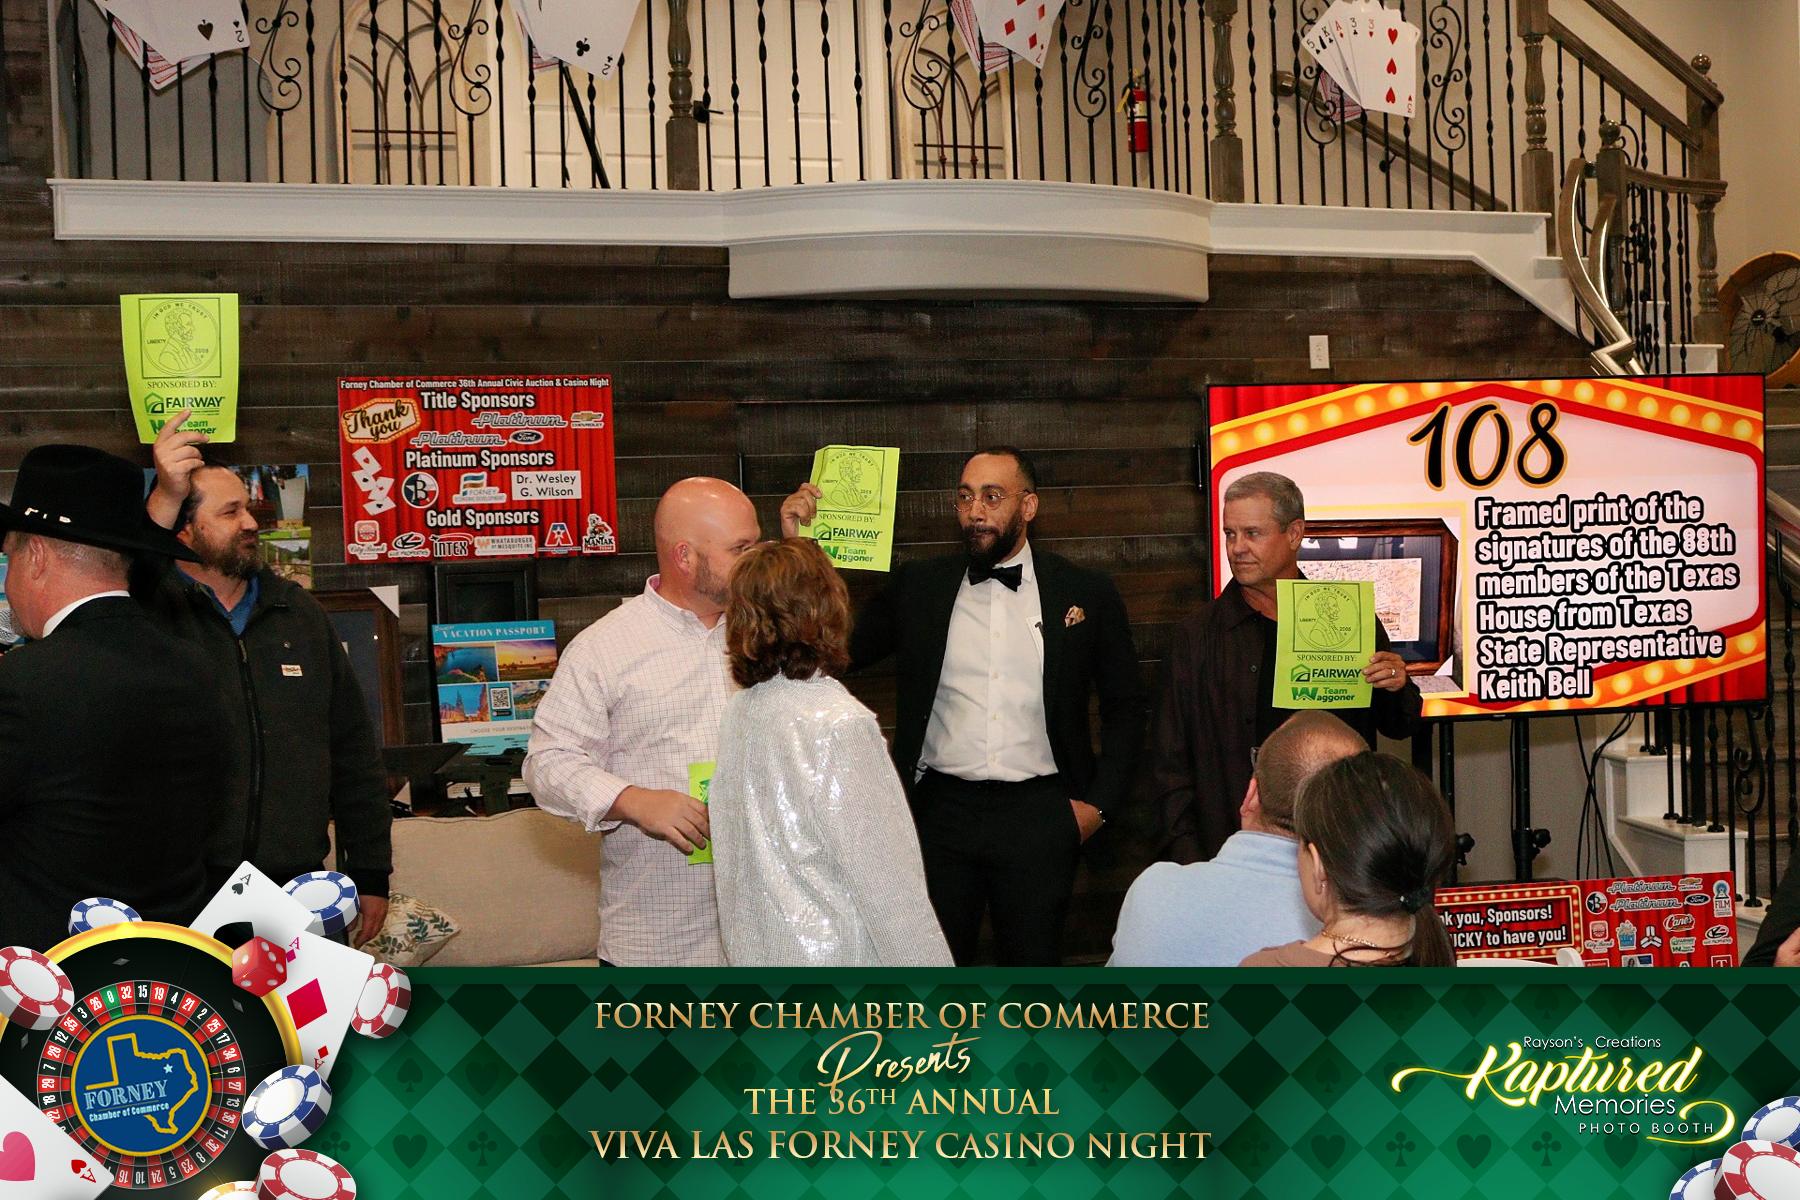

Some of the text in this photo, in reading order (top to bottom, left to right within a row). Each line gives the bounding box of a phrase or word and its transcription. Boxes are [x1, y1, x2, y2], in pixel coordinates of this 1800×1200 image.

[1335, 20, 1342, 31] A
[1350, 17, 1358, 28] 3
[1368, 19, 1375, 30] 3
[1321, 26, 1331, 38] K
[1306, 38, 1316, 49] 5
[147, 380, 217, 389] SPONSORED BY:
[340, 378, 609, 390] Forney Chamber of Commerce 36th Annual Civic Auction & Casino Night
[166, 396, 223, 408] FAIRWAY
[420, 391, 535, 412] Title Sponsors
[343, 399, 410, 434] Thank
[472, 412, 567, 428] Platinum
[184, 420, 209, 428] eam
[370, 421, 401, 442] you
[411, 431, 537, 446] Platinum Ford
[1407, 400, 1568, 491] 108
[405, 449, 554, 470] Platinum Sponsors
[516, 473, 577, 485] Dr. Wesley
[414, 479, 428, 499] B
[520, 487, 574, 497] G. Wilson
[819, 512, 862, 522] SPONSORED
[1476, 492, 1702, 531] Framed print of the
[426, 508, 540, 530] Gold Sponsors
[832, 527, 880, 540] FAIRWAY
[843, 546, 867, 555] Team
[1477, 526, 1734, 569] signatures of the 88th
[1478, 562, 1738, 597] members of the Texas
[1478, 599, 1690, 631] House from Texas
[442, 628, 494, 639] VACATION
[495, 626, 547, 637] PASSPORT
[1479, 629, 1723, 668] State Representative
[1297, 654, 1356, 662] SPONSORED BY:
[1312, 668, 1361, 679] FAIRWAY
[1479, 668, 1591, 700] Keith Bell
[1715, 899, 1731, 909] FILM
[1456, 911, 1484, 928] you,
[1487, 904, 1553, 925] Sponsors!
[1450, 931, 1483, 948] UCKY
[1486, 932, 1500, 945] to
[1503, 929, 1535, 944] have
[1538, 926, 1567, 946] you!
